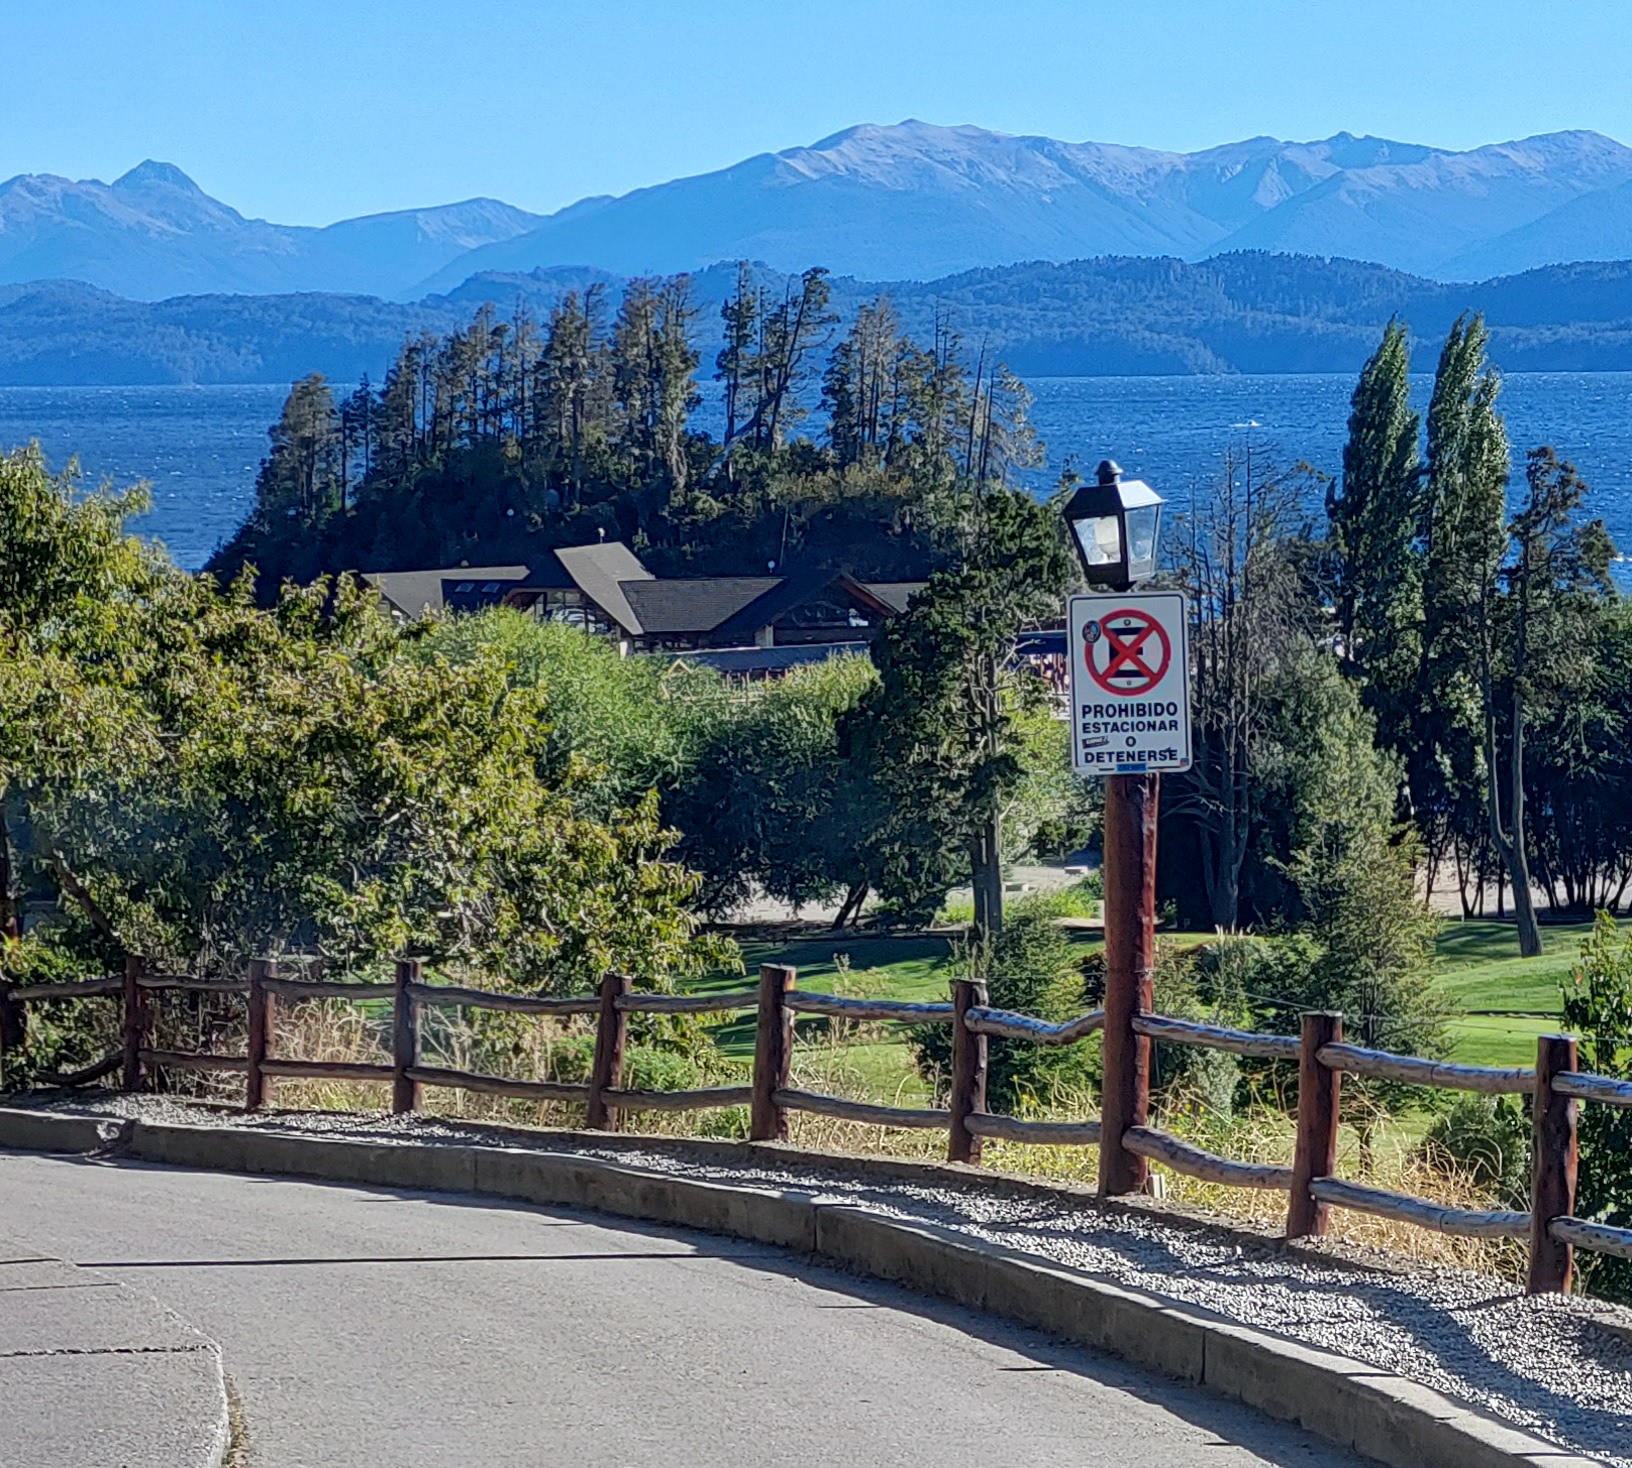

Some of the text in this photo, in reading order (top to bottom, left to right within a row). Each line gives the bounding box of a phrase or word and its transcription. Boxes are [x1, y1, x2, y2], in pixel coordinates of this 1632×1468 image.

[1082, 702, 1178, 719] PROHIBIDO
[1082, 720, 1178, 734] ESTACIONAR
[1125, 736, 1137, 747] O
[1084, 749, 1178, 763] DETENERSE
